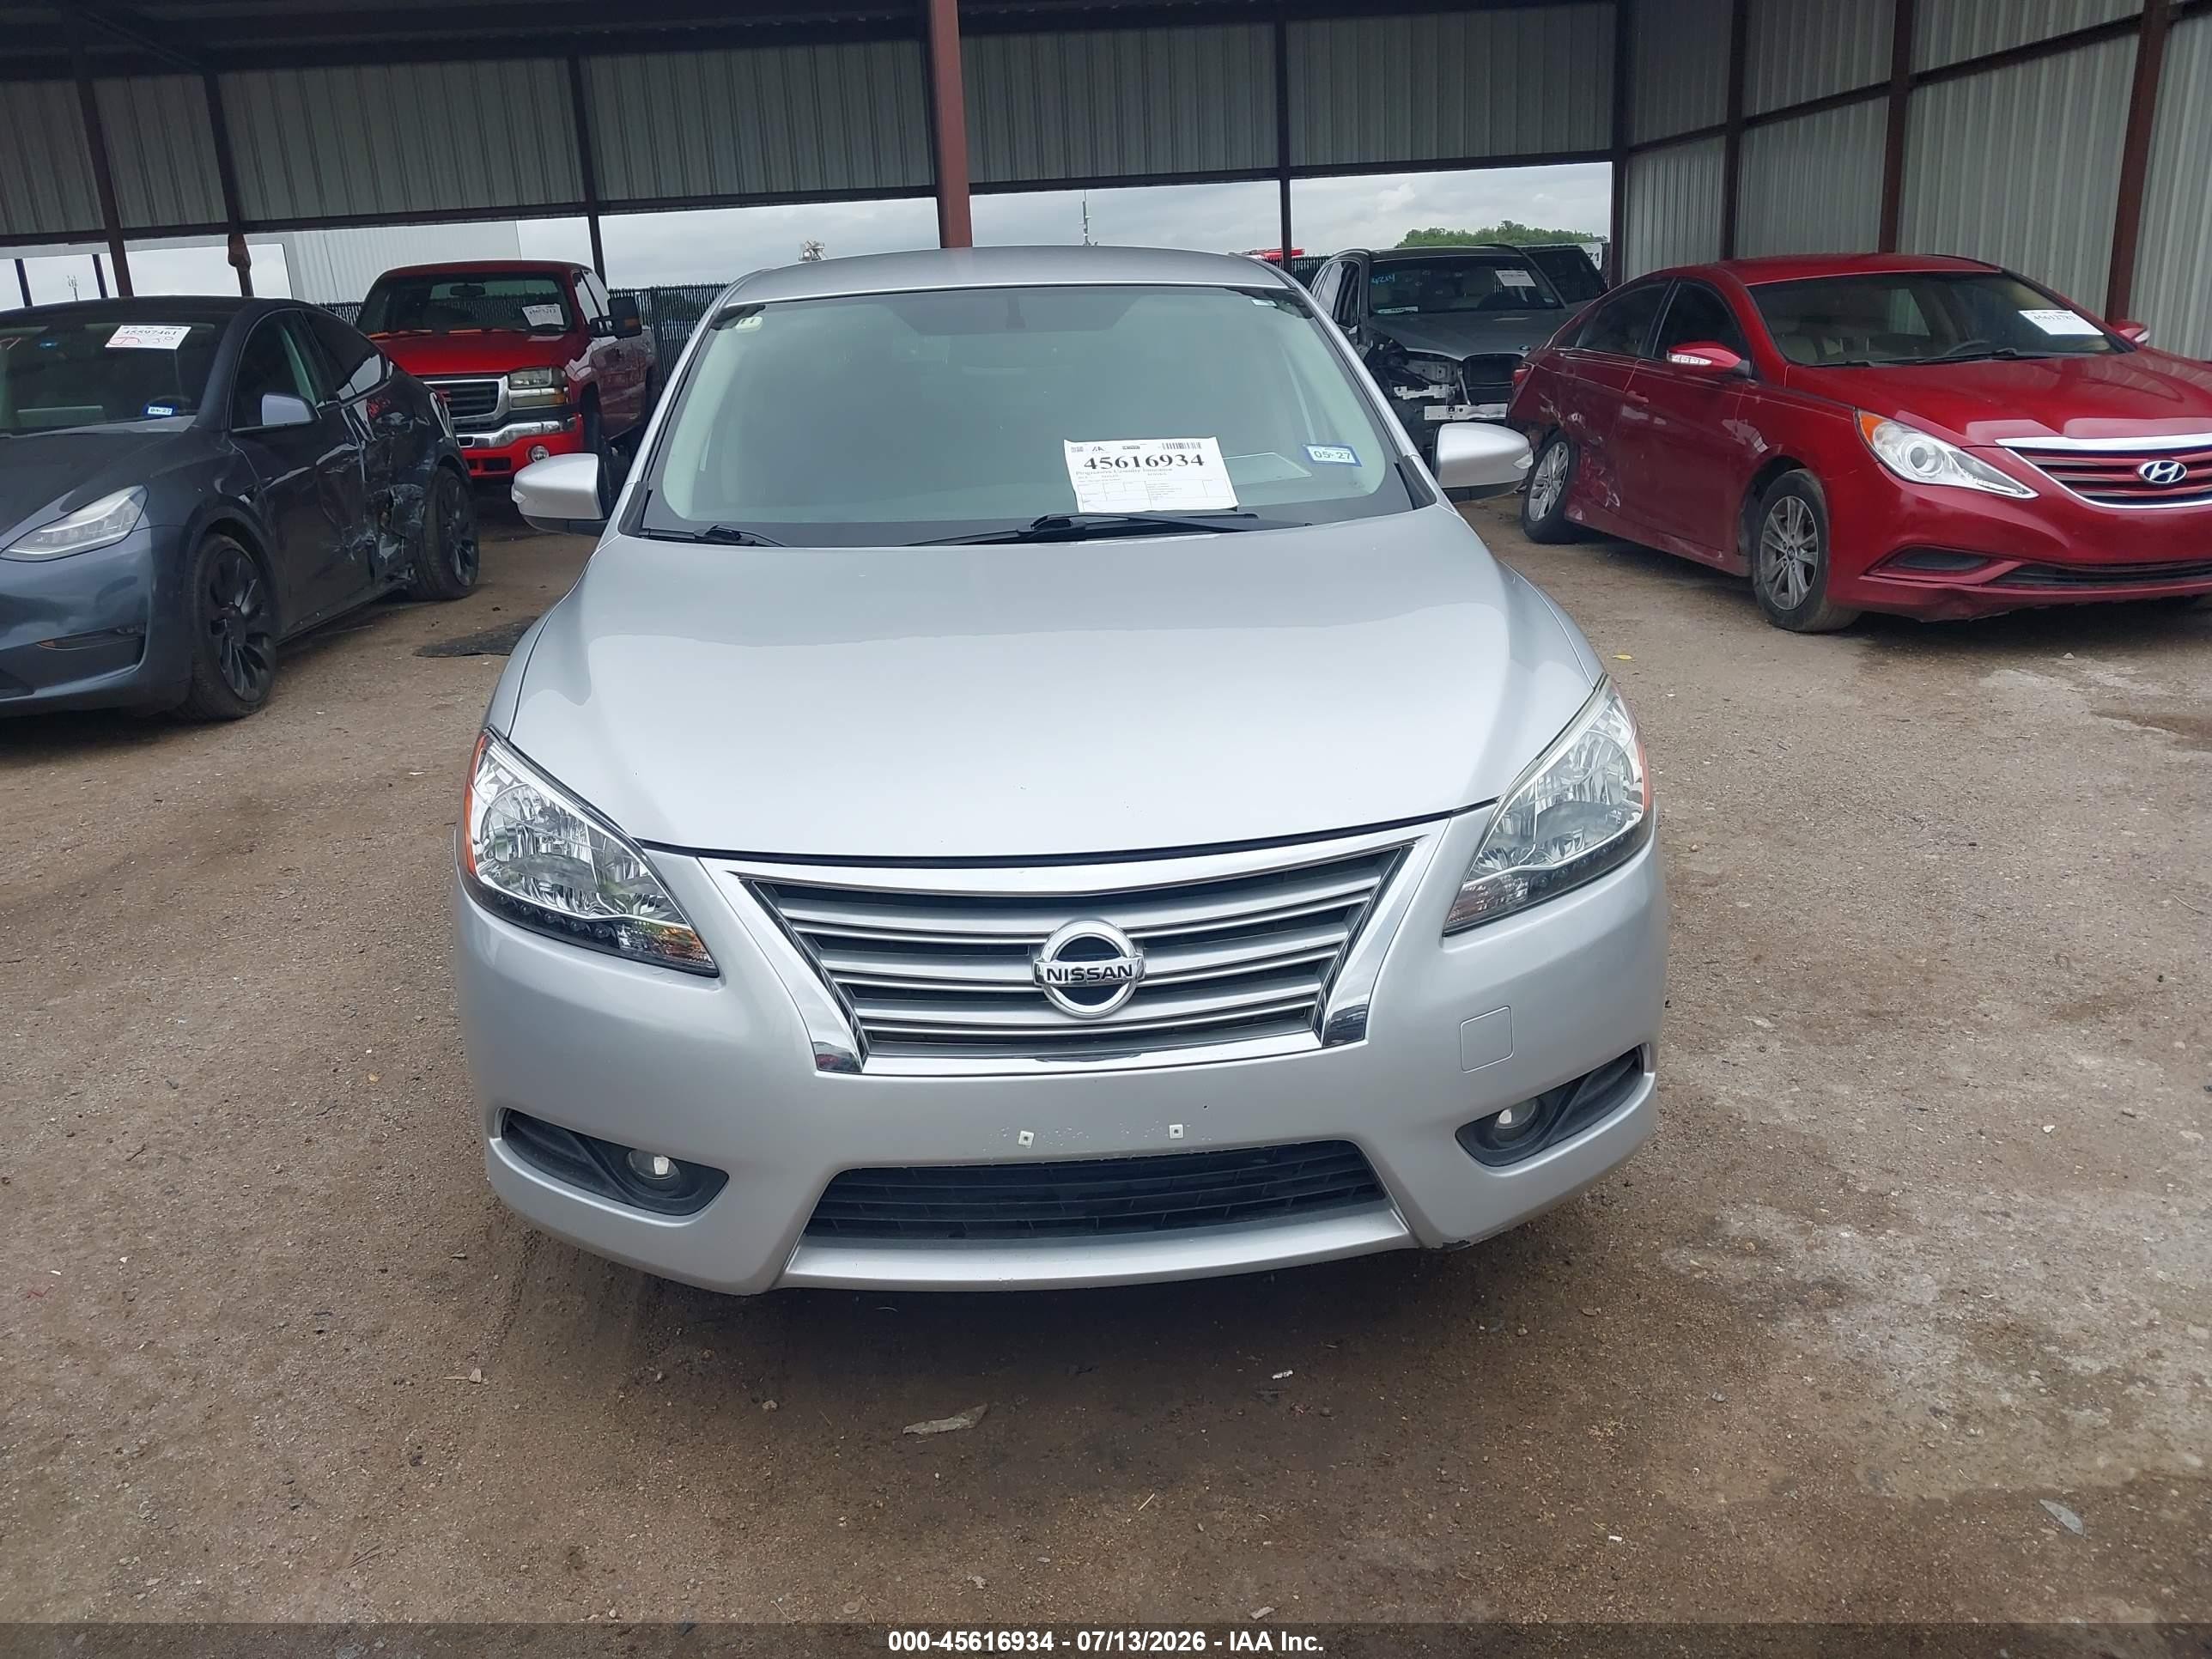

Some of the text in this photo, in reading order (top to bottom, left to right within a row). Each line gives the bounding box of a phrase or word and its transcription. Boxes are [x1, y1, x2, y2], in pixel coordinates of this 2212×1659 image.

[1083, 453, 1205, 471] 45616934
[1313, 450, 1351, 460] 05-27
[1046, 963, 1133, 982] NISSAN
